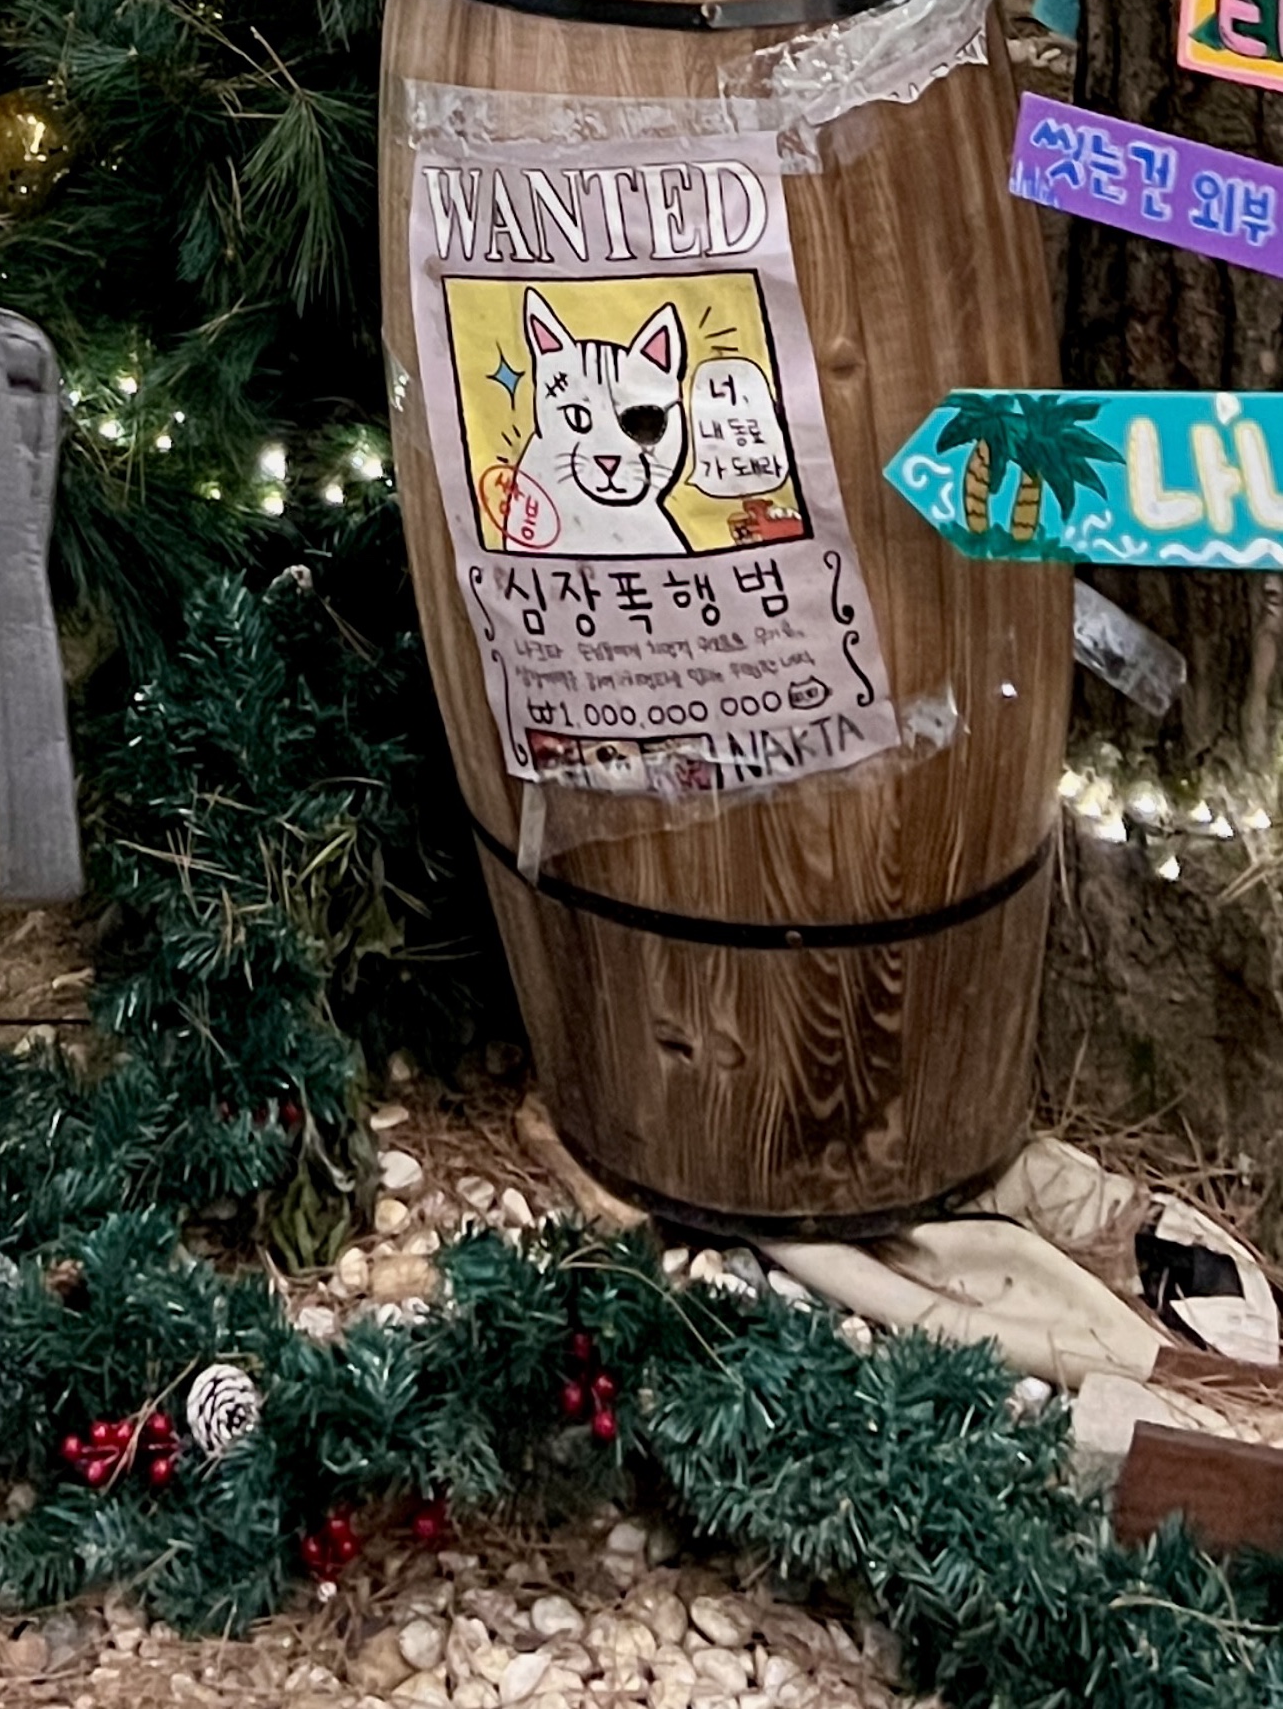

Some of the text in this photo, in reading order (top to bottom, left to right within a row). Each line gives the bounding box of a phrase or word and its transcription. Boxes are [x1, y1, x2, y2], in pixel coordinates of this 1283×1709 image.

[421, 158, 769, 263] WANTED
[1188, 170, 1276, 247] 외부
[698, 419, 725, 441] 내
